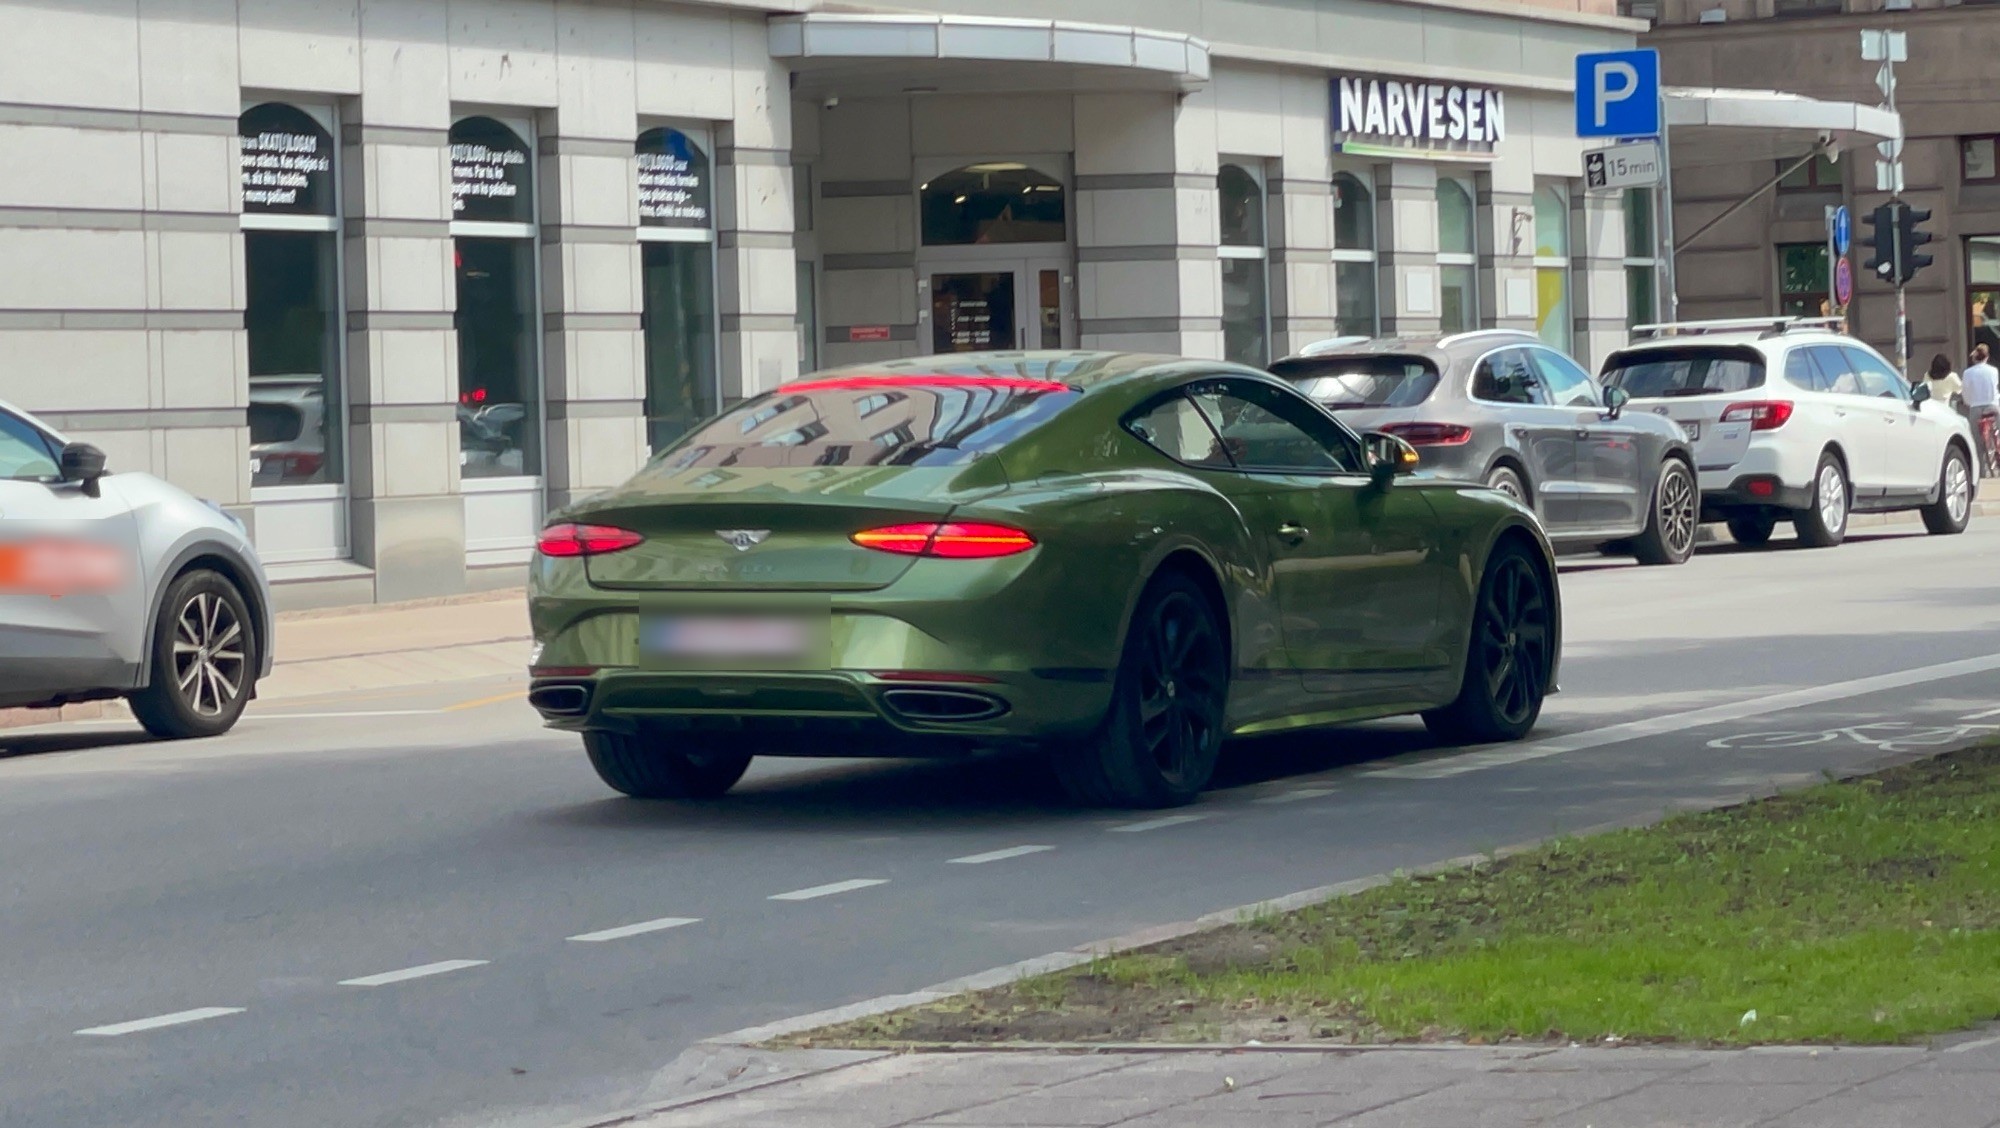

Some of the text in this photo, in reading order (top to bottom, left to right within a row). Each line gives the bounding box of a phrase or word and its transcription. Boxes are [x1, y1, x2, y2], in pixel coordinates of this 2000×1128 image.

[1340, 76, 1505, 142] NARVESEN
[1594, 62, 1639, 127] P
[1608, 159, 1655, 177] 15 min
